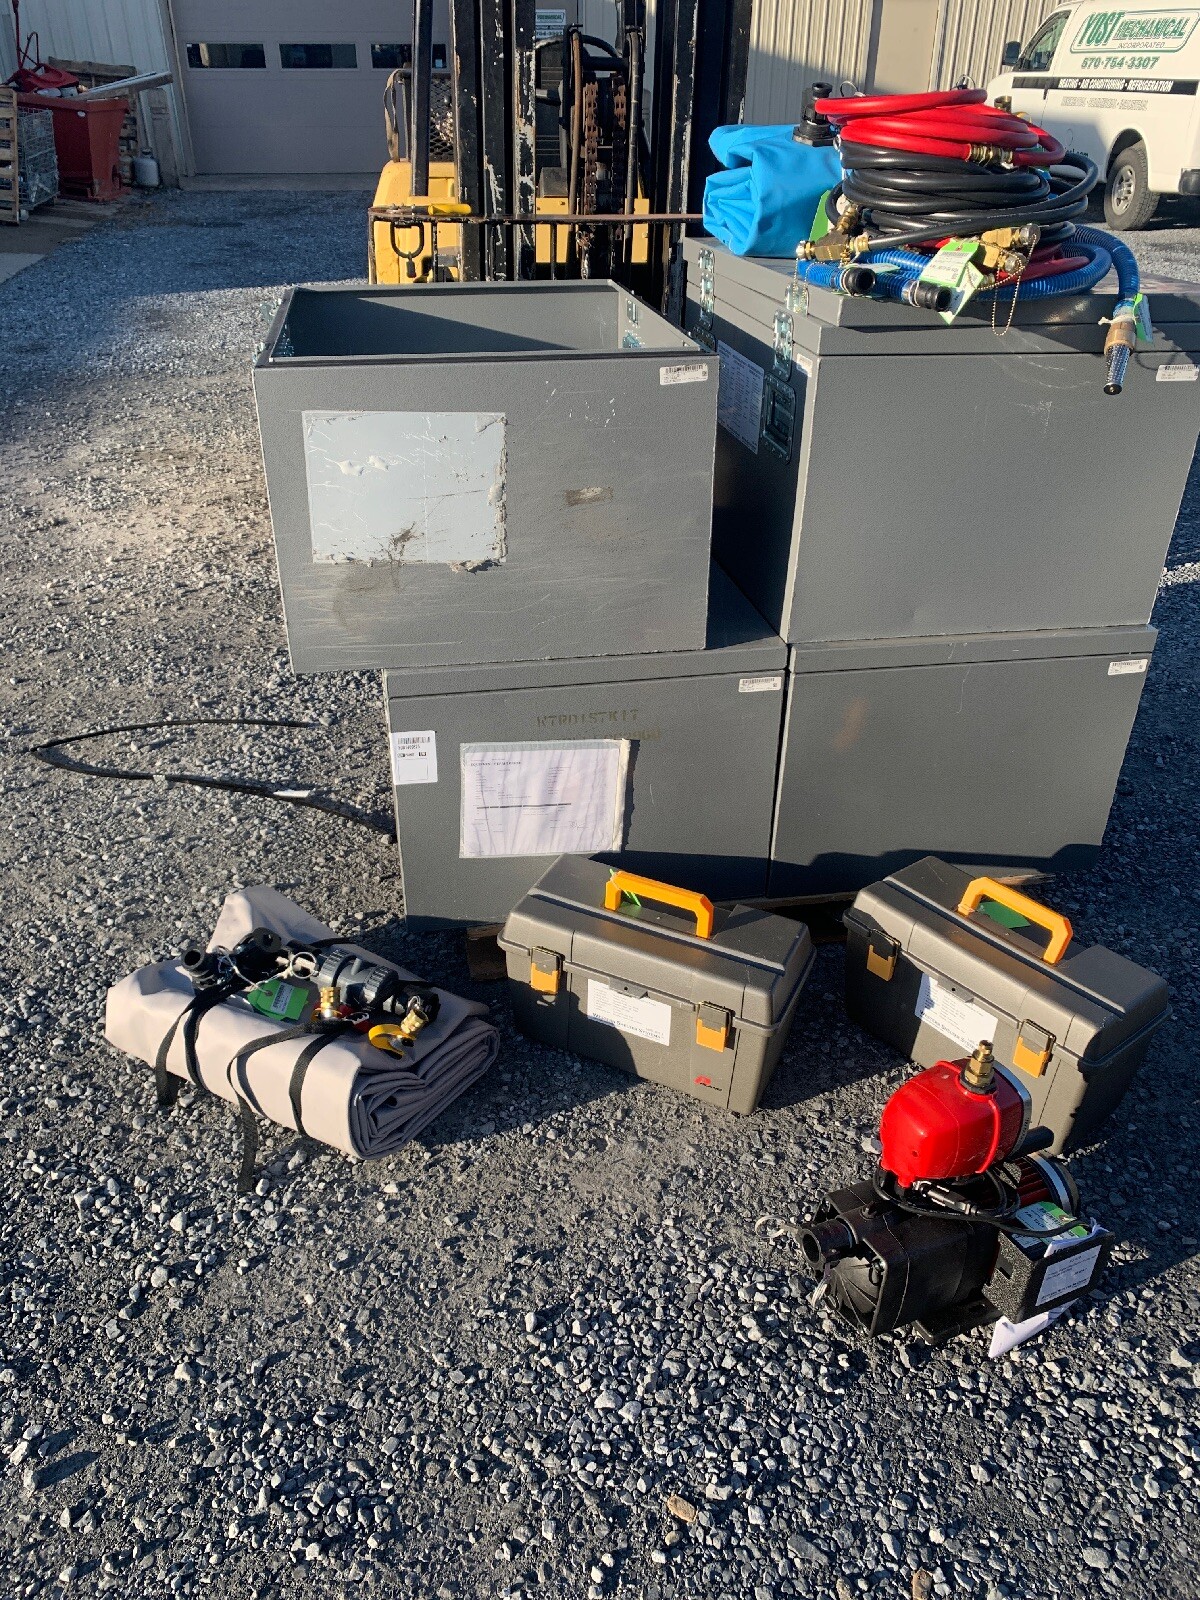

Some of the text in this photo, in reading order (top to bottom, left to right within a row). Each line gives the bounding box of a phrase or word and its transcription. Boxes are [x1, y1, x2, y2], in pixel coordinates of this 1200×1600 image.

[1077, 11, 1190, 46] YOST MECHANICAL
[1117, 41, 1165, 49] INCORPORATED
[1089, 79, 1126, 91] CONDITIONING
[1127, 79, 1174, 92] REFRIGERATION
